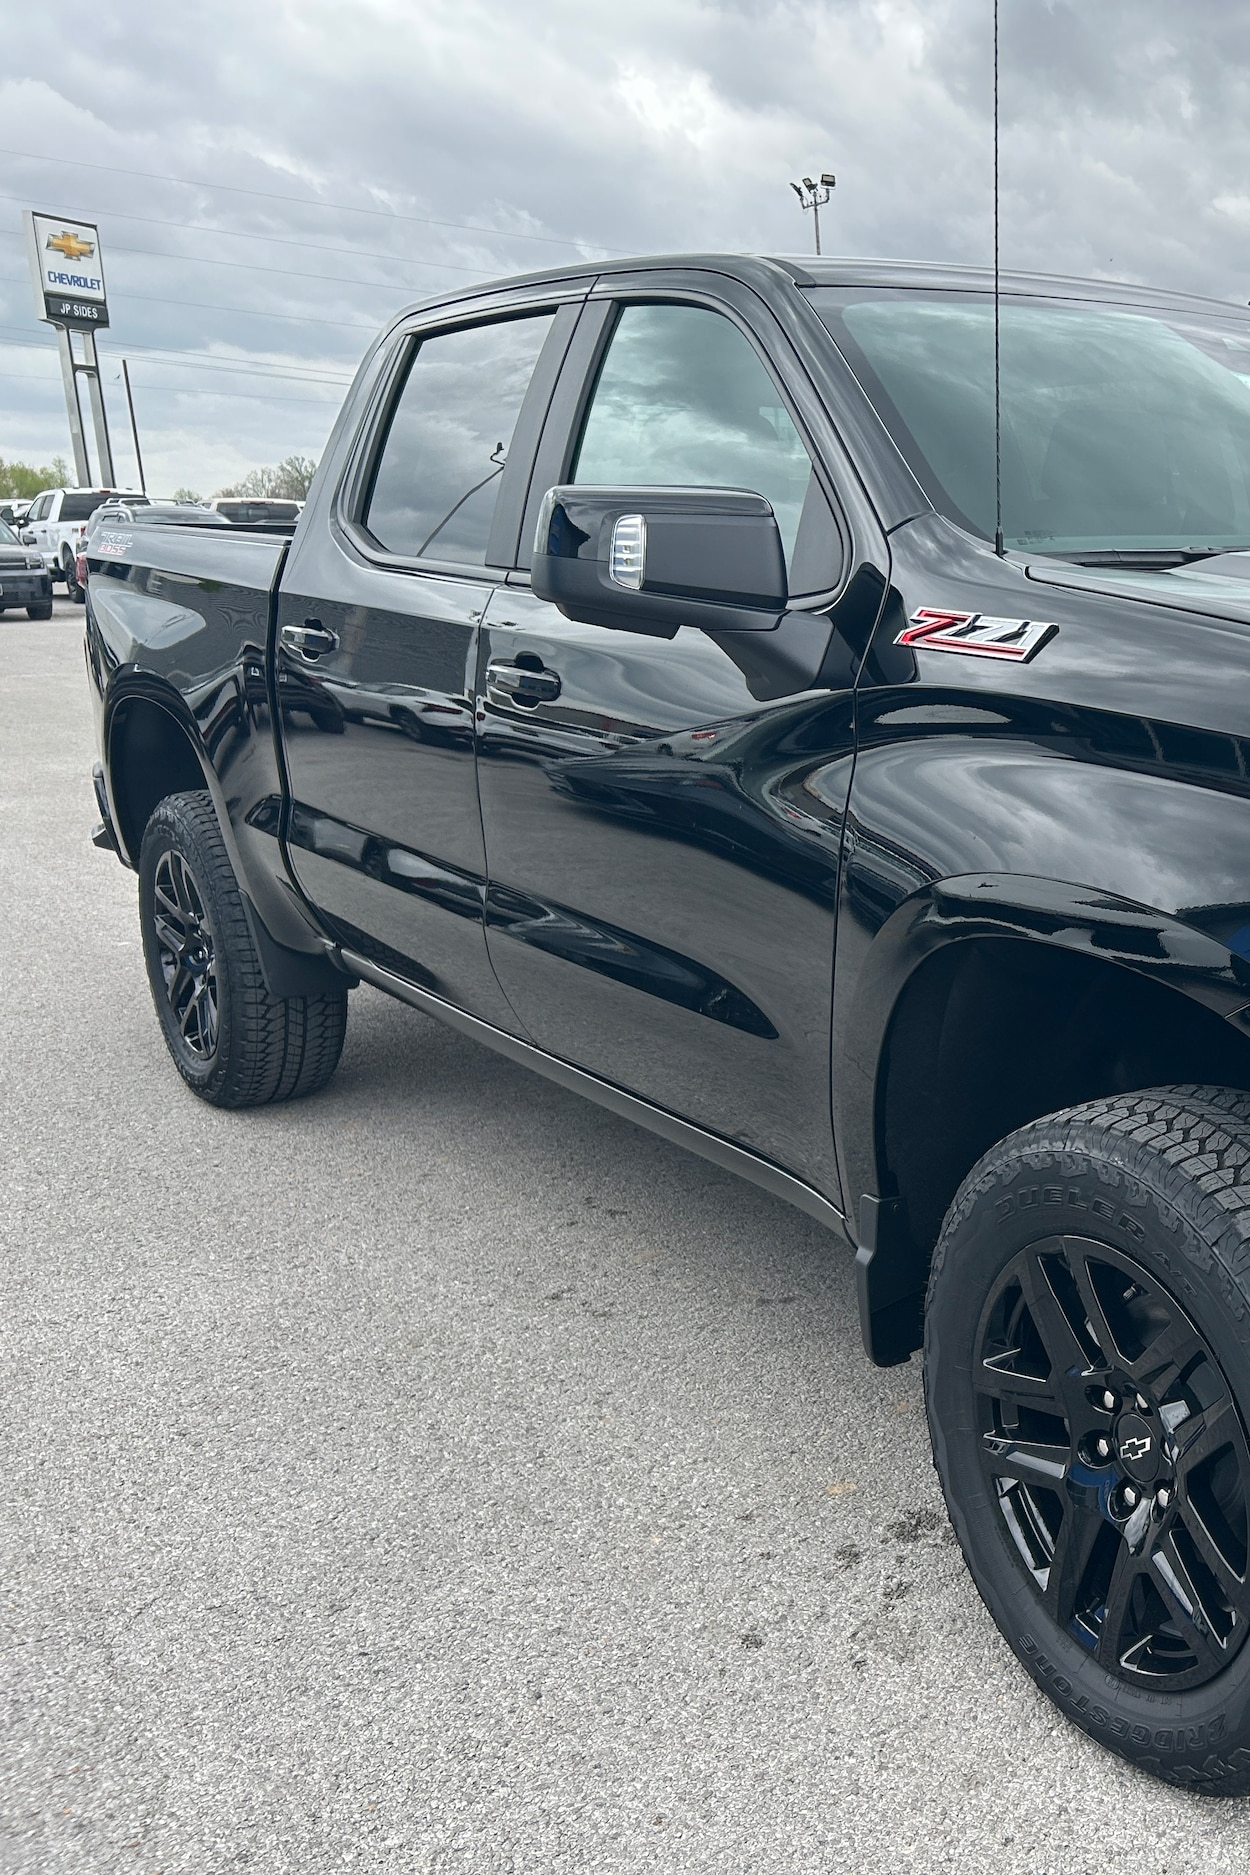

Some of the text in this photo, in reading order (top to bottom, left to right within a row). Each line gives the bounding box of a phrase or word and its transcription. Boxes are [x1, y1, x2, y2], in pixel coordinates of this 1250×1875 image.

[48, 271, 101, 290] CHEVROLET
[60, 303, 98, 319] JP SIDES
[101, 531, 133, 547] TRAIL
[98, 543, 126, 556] BOSS
[892, 605, 1060, 665] Z71
[994, 1183, 1146, 1244] DUELER
[1017, 1633, 1228, 1752] BRIDGESTONE
